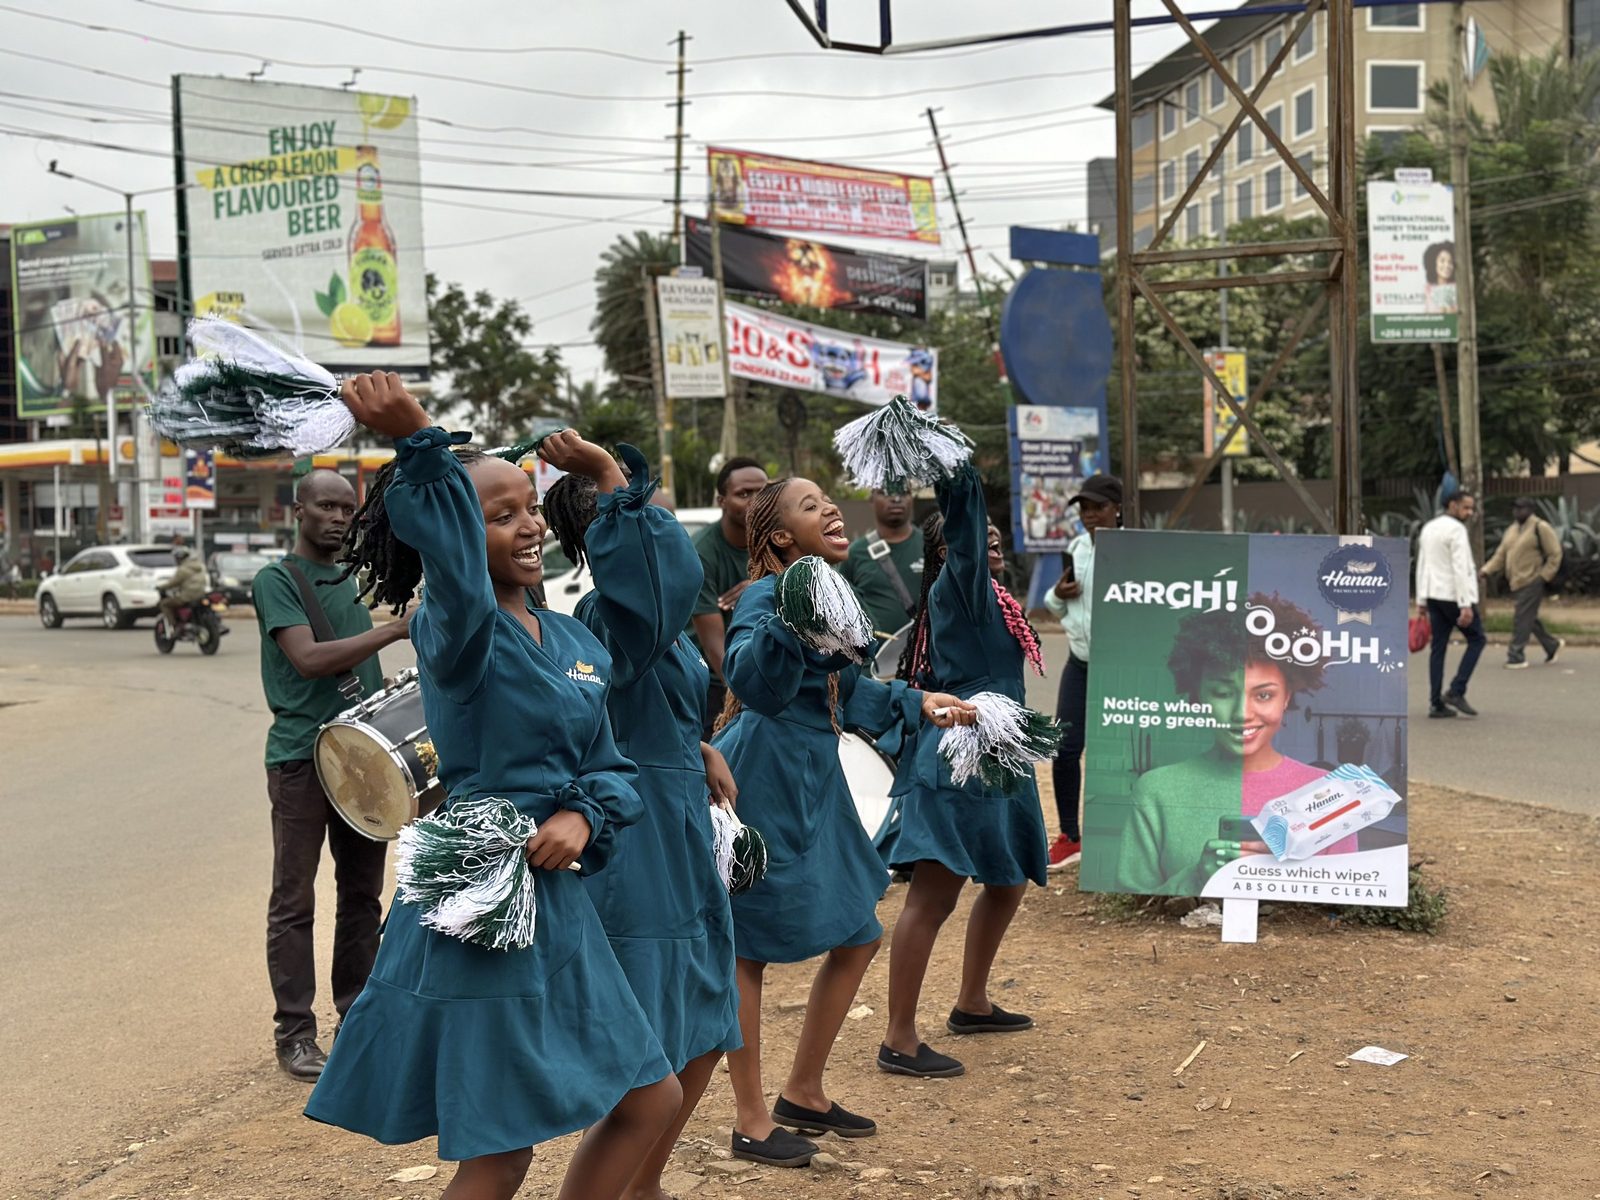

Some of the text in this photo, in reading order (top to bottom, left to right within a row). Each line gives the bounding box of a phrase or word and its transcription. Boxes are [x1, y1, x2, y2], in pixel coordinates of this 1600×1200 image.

[269, 119, 337, 156] ENJOY
[213, 149, 338, 188] A CRISP LEMON
[213, 174, 339, 220] FLAVOURED
[287, 203, 341, 238] BEER
[1376, 214, 1446, 222] INTERNATIONAL
[1373, 224, 1451, 232] MONEY TRANSFER
[1321, 570, 1388, 588] Hanan
[1103, 579, 1239, 613] ARRGH!
[565, 667, 605, 686] Hanan
[1103, 696, 1213, 714] Notice when
[1101, 713, 1232, 729] you go green...
[1304, 791, 1345, 813] Hanan
[1237, 864, 1381, 884] Guess which wipe?
[1232, 881, 1388, 898] ABSOLUTE CLEAN
